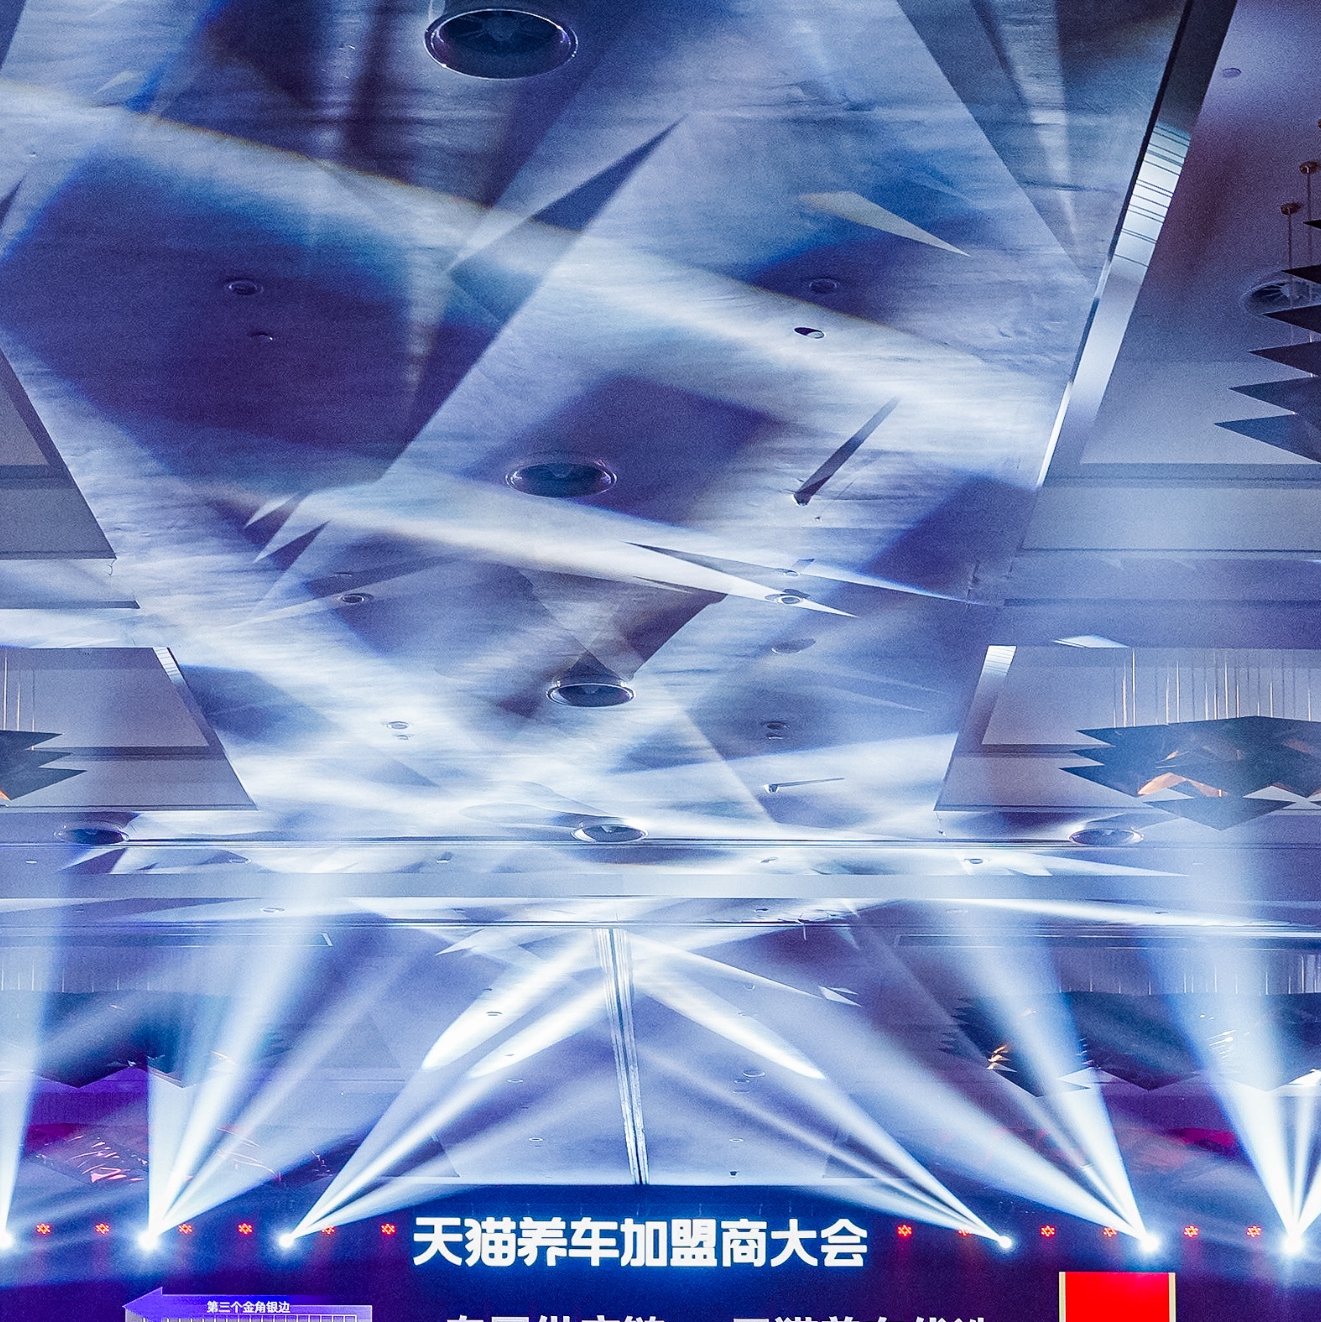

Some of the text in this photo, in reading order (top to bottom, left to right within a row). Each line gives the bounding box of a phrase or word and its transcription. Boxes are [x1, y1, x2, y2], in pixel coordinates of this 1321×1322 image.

[413, 1217, 868, 1268] 天猫养车加盟商大会
[207, 1301, 290, 1314] 第三个金角银边
